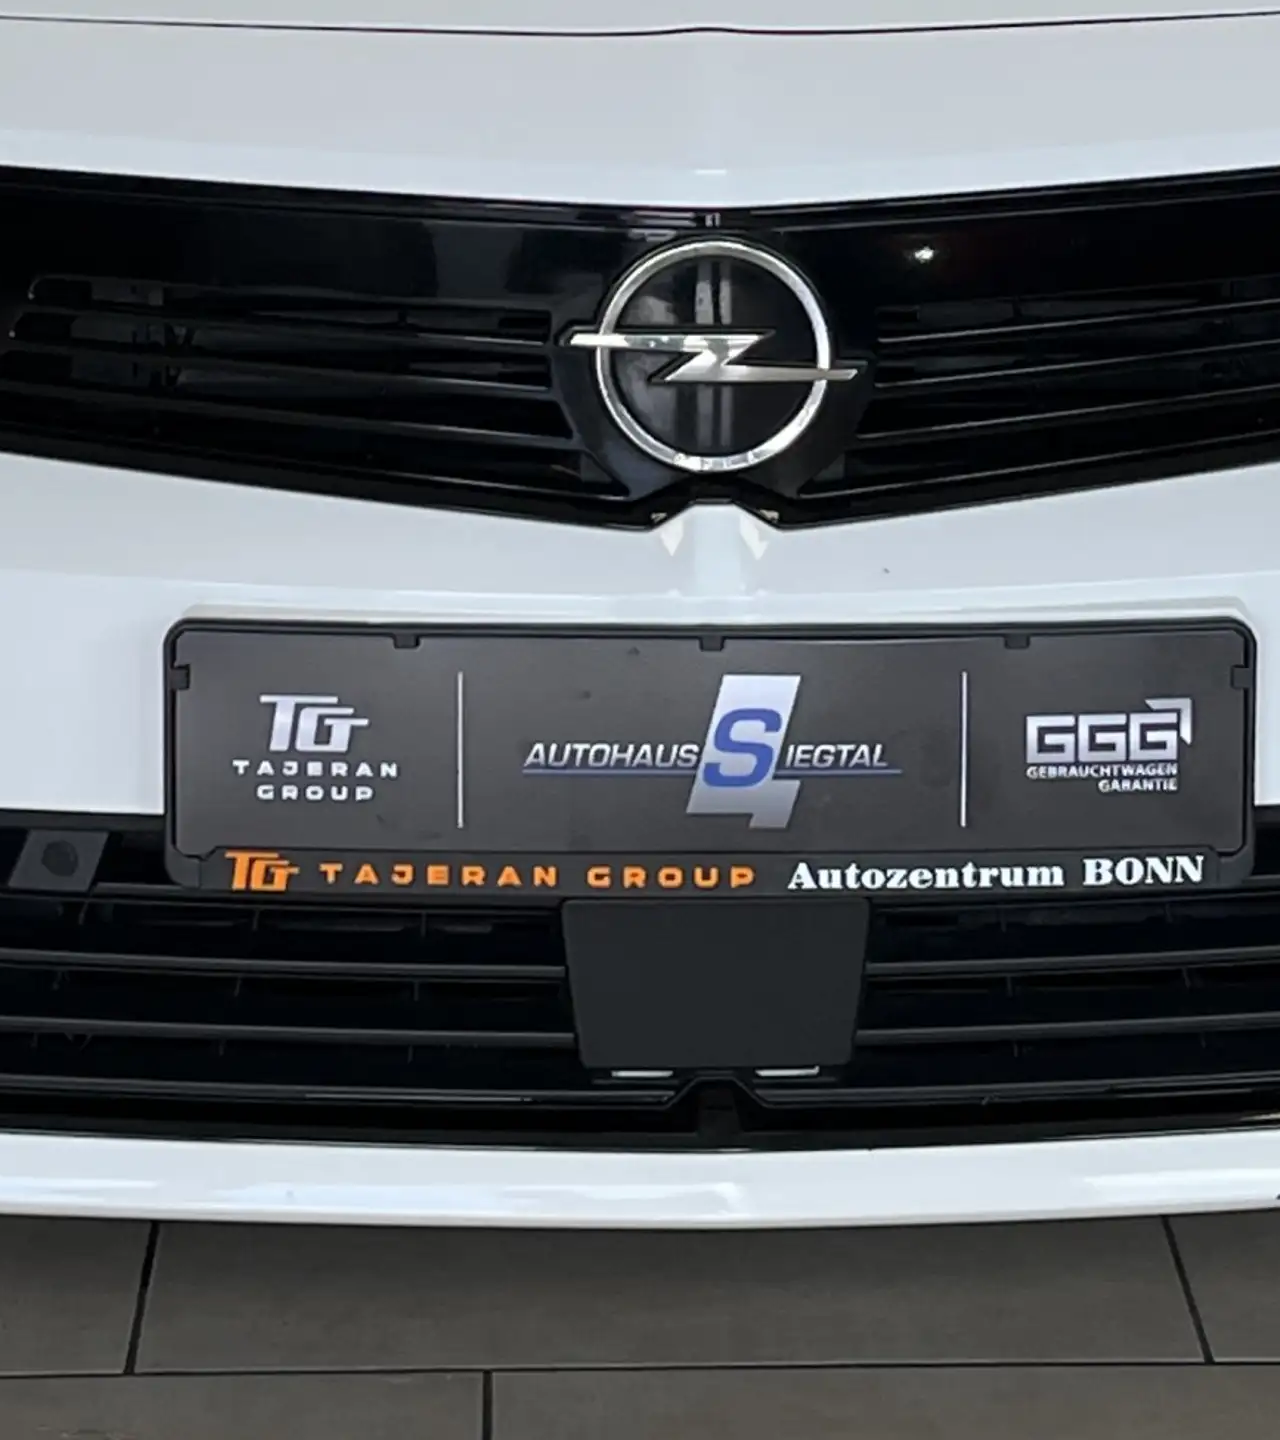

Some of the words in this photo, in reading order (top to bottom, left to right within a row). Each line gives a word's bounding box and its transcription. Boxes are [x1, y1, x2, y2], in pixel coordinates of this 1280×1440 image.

[1026, 712, 1178, 764] GGG
[523, 742, 701, 768] AUTOHAUS
[232, 759, 398, 778] TAJERAN
[1026, 763, 1178, 779] GEBRAUCHTWAGEN
[256, 784, 373, 801] GROUP
[1098, 778, 1178, 793] GARANTIE
[320, 863, 557, 887] TAJERAN
[587, 866, 755, 888] GROUP
[787, 861, 1065, 890] Autozentrum
[1082, 855, 1205, 886] BONN
